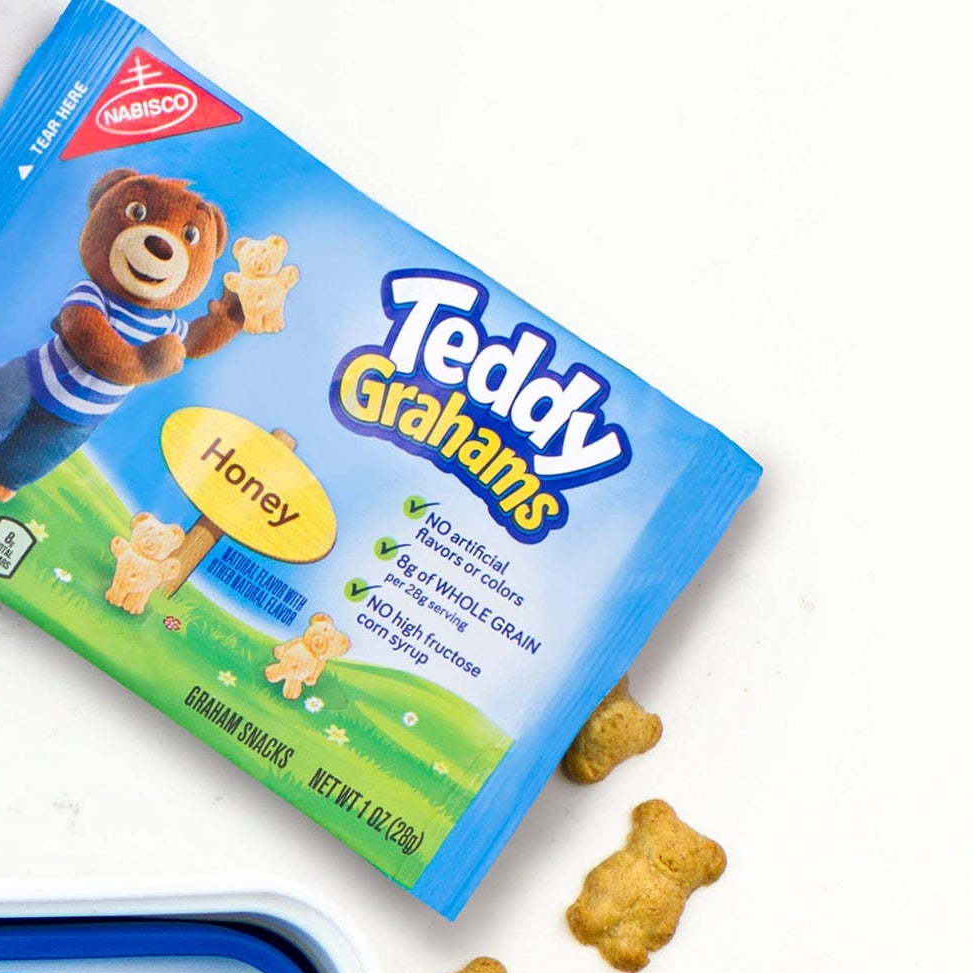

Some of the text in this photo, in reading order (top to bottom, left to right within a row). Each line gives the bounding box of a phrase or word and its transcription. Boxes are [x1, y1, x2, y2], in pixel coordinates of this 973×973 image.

[30, 81, 89, 155] TEAR HERE
[103, 93, 189, 126] NABISCO
[389, 277, 622, 476] Teddy
[201, 437, 300, 527] Honey
[339, 353, 560, 531] Grahams
[221, 545, 309, 612] NATURAL FLAVOR WITH
[415, 527, 524, 607] flavors or colors
[425, 512, 510, 575] NO artificial
[206, 557, 298, 627] OTHER NATURAL FLAVOR
[384, 572, 469, 633] per 28g serving
[396, 554, 542, 655] 8g of WHOLE GRAIN
[356, 613, 429, 666] corn syrup
[366, 595, 481, 678] NO high fructose
[184, 685, 295, 769] GRAHAM SNACKS
[308, 767, 425, 856] NET WT 1 OZ (28g)
